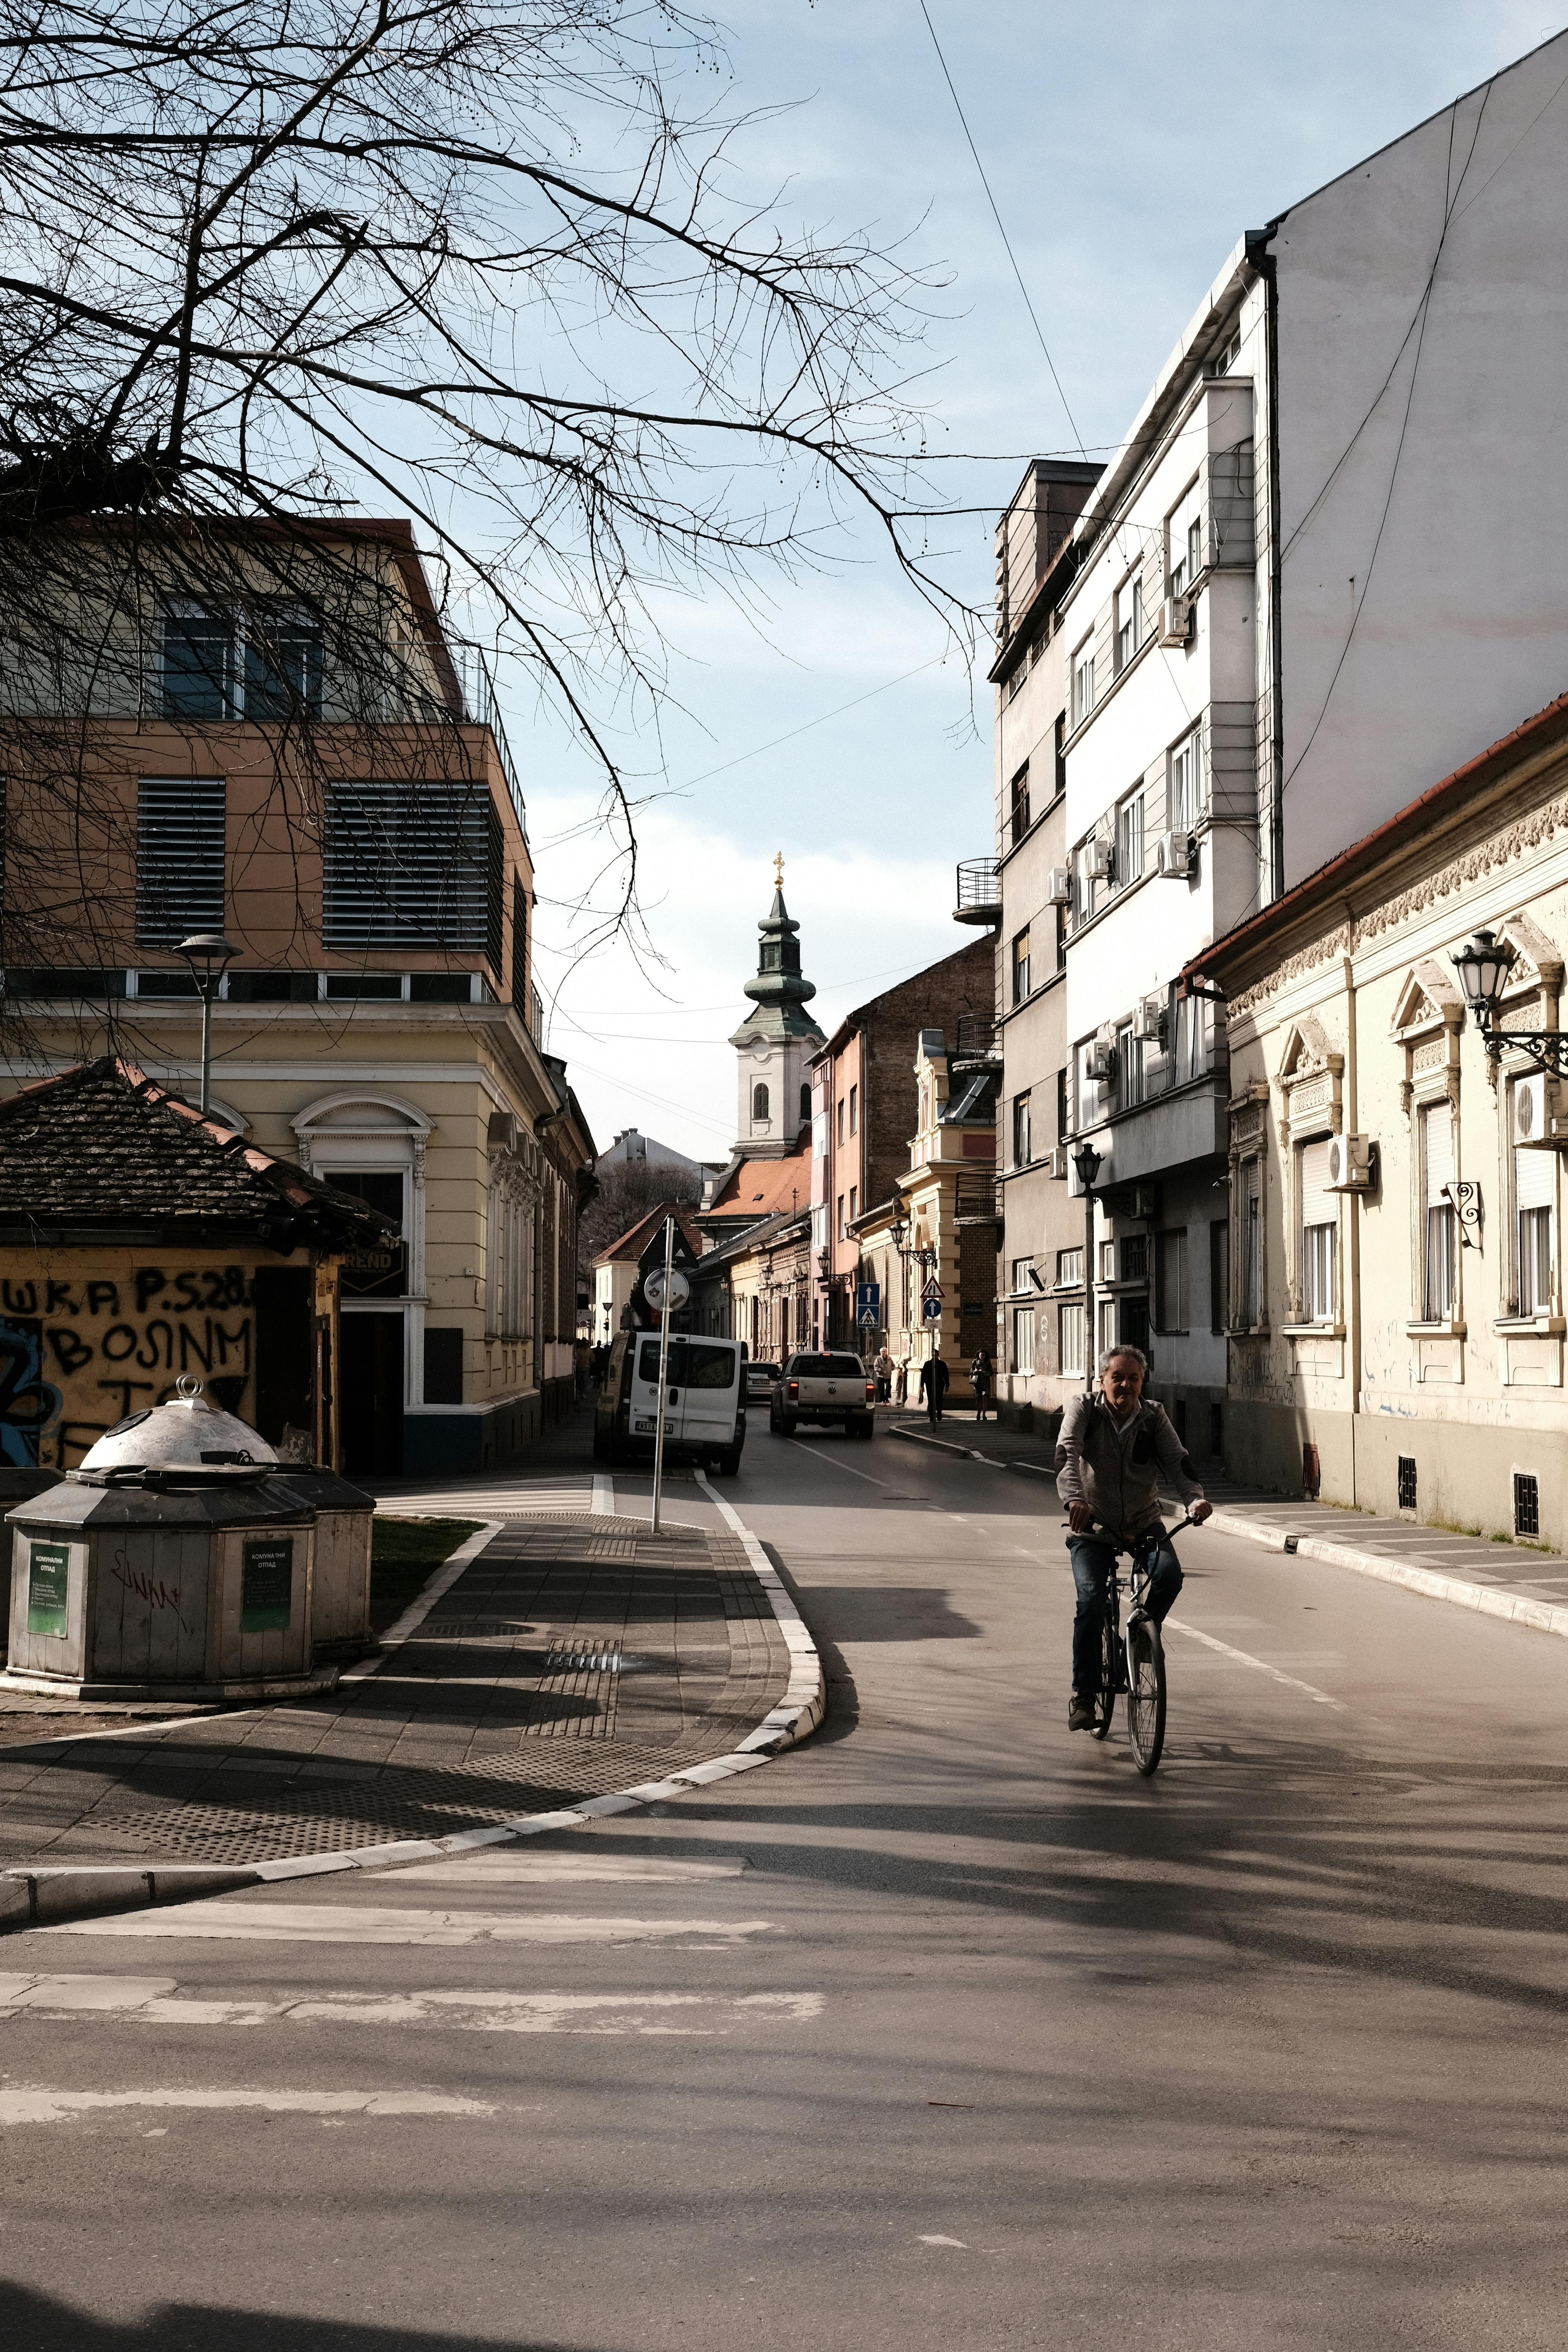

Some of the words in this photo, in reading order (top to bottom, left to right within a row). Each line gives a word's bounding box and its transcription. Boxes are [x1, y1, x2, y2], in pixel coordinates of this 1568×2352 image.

[345, 1254, 392, 1268] REND
[36, 1556, 63, 1564] КОМУНАЛНИ
[40, 1565, 55, 1573] ОТПАД
